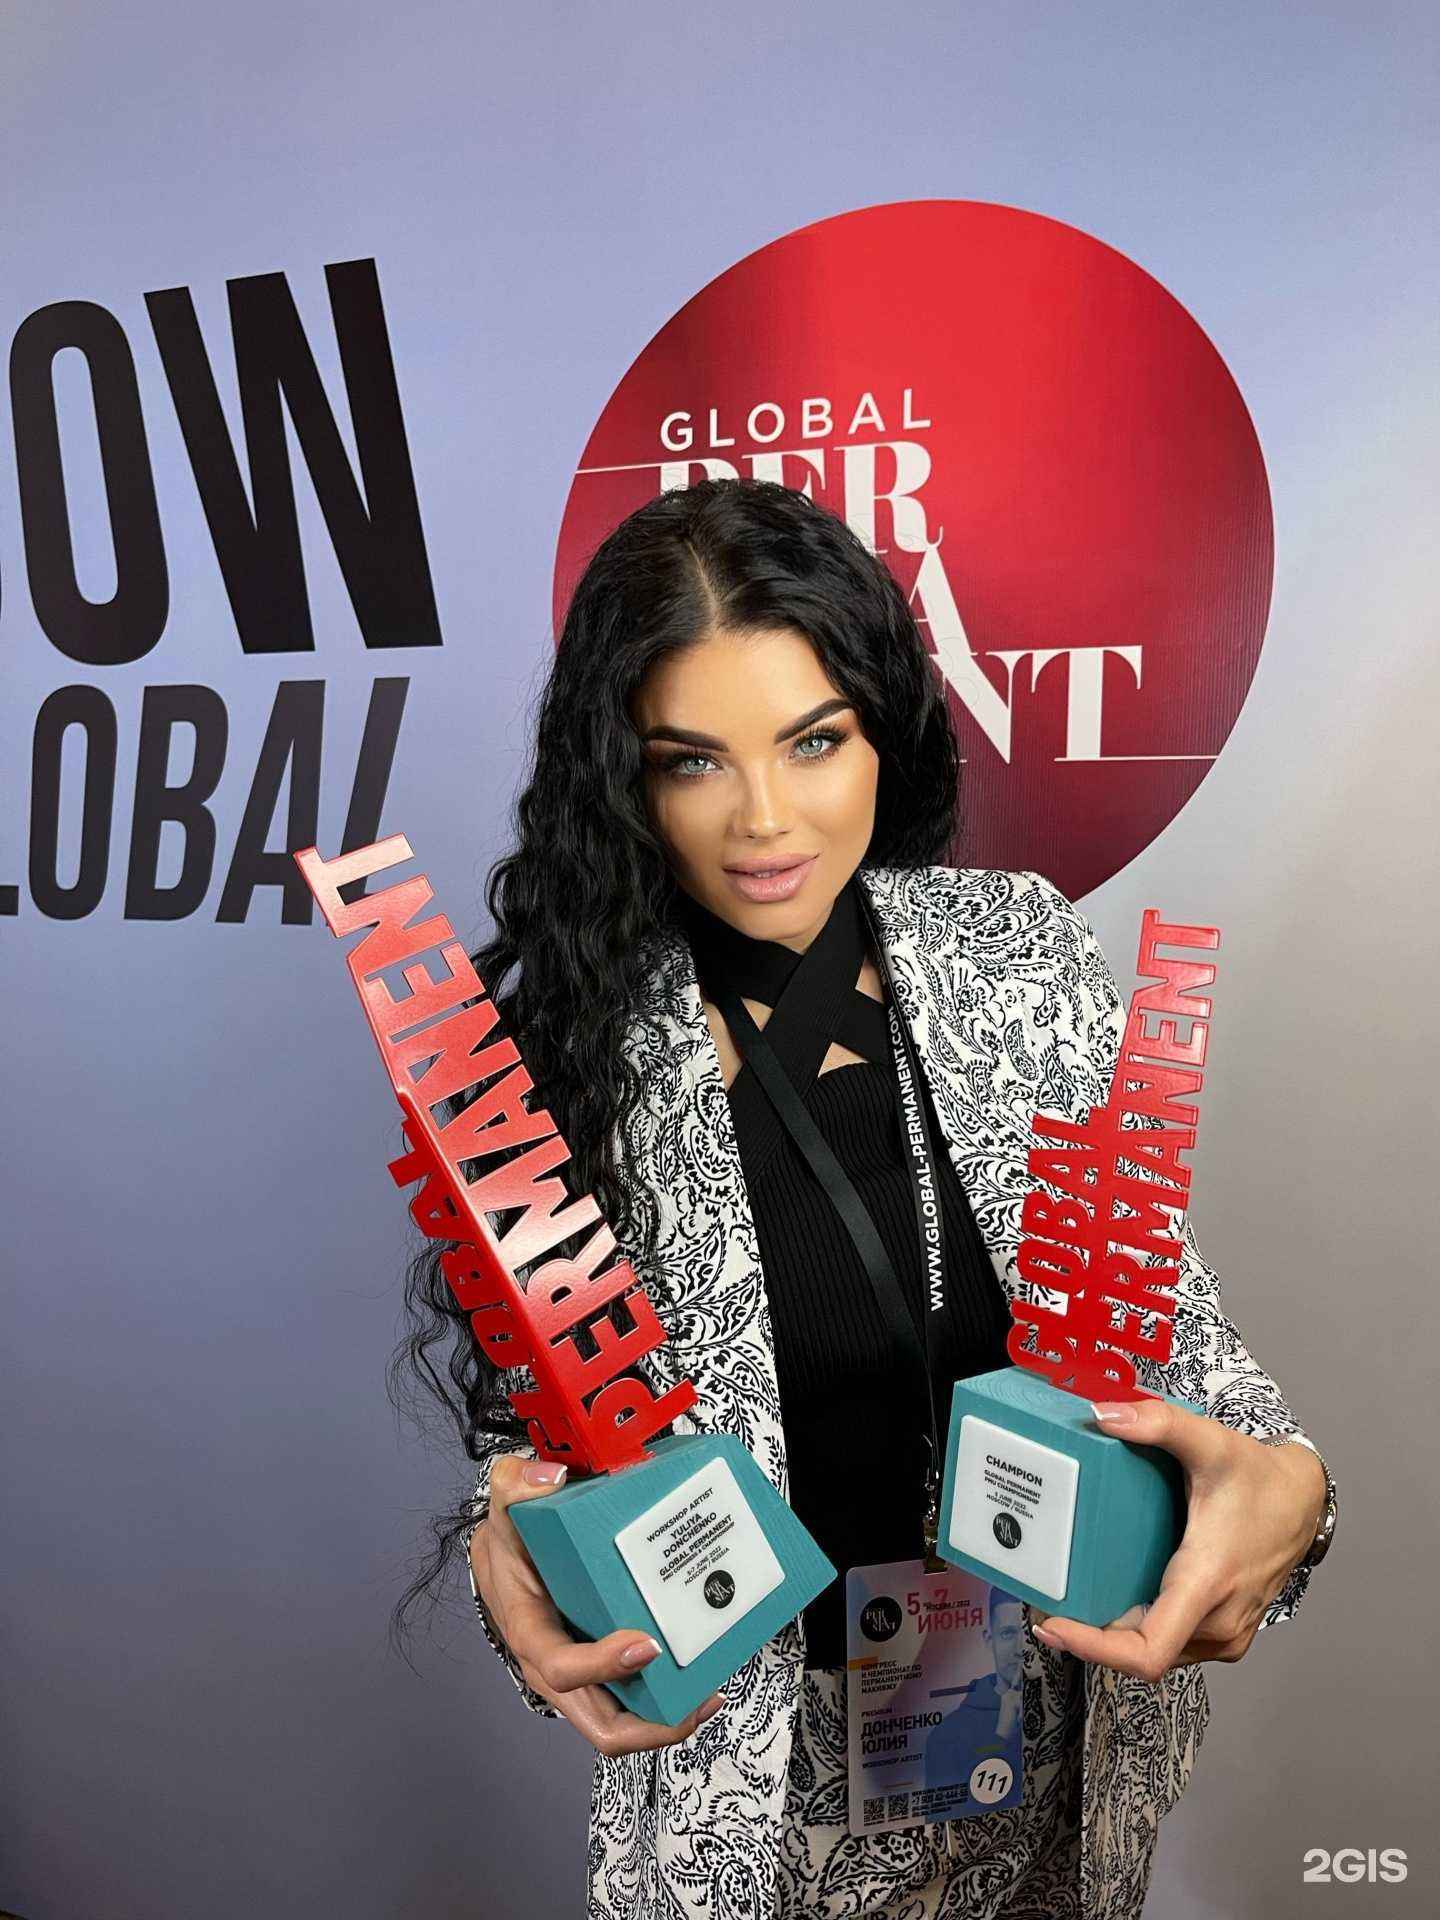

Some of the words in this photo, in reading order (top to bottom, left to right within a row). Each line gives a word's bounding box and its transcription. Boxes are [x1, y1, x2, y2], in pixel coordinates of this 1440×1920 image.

[660, 388, 932, 452] GLOBAL
[0, 257, 443, 666] OW
[0, 677, 410, 926] OBAL
[293, 832, 699, 1472] PERMANENT
[888, 1006, 945, 1312] WWW.GLOBAL-PERMANENT.COM
[1088, 908, 1221, 1401] PERMANENT
[1007, 1107, 1102, 1378] GLOBAL
[984, 1469, 1006, 1484] GLOBAL
[1006, 1479, 1042, 1499] PERMANENT
[985, 1454, 1043, 1487] CHAMPION
[646, 1507, 688, 1543] WORKSHOP
[689, 1487, 714, 1511] ARTIST
[987, 1494, 1010, 1508] MOSCOW
[659, 1550, 690, 1577] GLOBAL
[689, 1513, 733, 1553] PERMANENT
[663, 1511, 718, 1559] DONCHENKO
[670, 1512, 702, 1540] YULIYA
[684, 1565, 708, 1586] MOSCOW
[917, 1607, 984, 1635] ИЮНЯ
[860, 1711, 943, 1740] ДОНЧЕНКО
[861, 1734, 908, 1756] ЮЛИЯ
[976, 1770, 1008, 1795] 111
